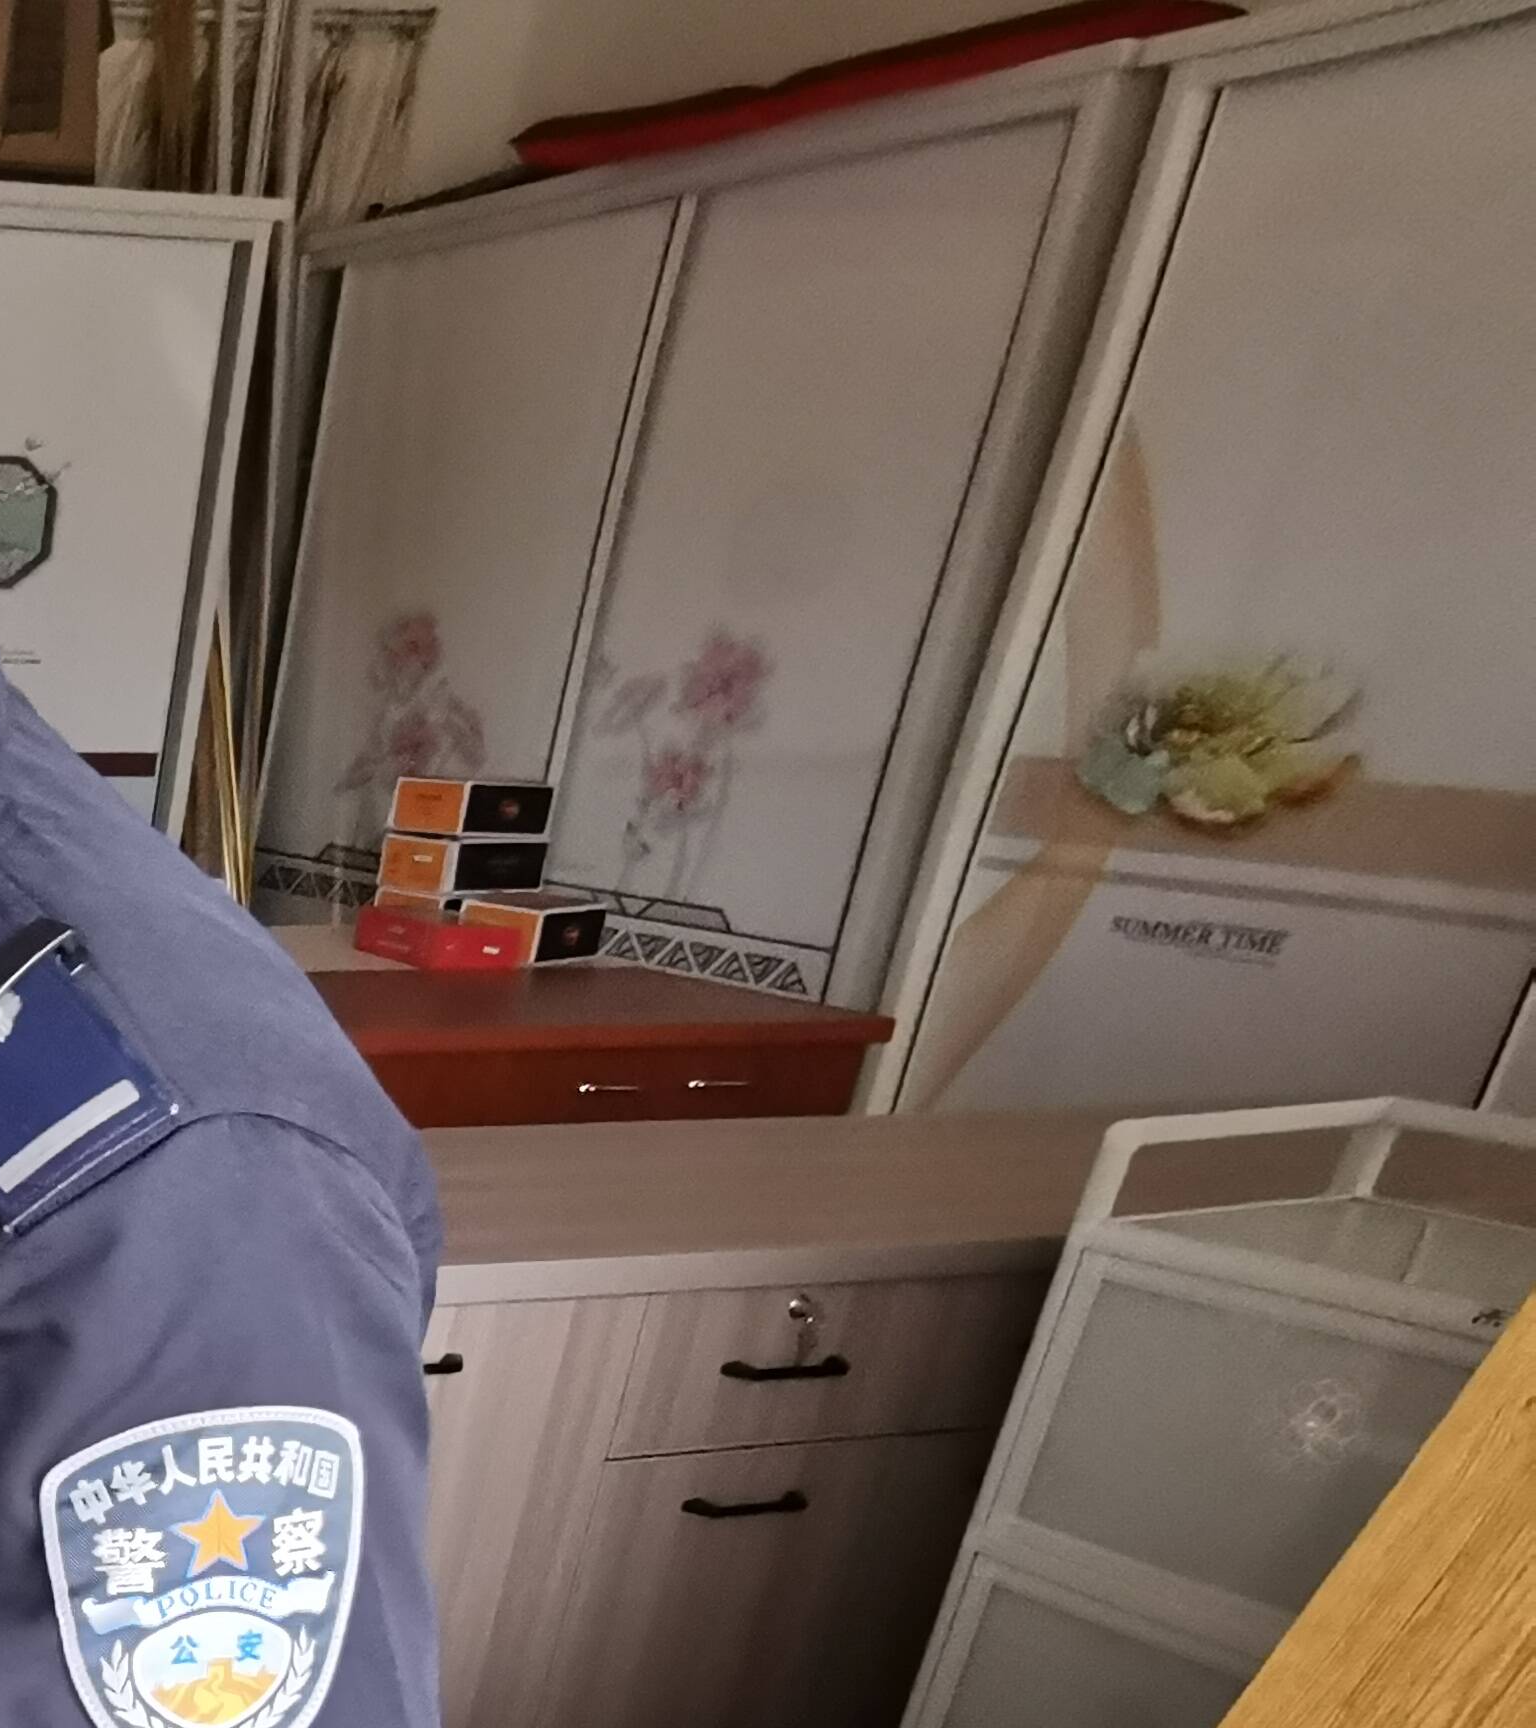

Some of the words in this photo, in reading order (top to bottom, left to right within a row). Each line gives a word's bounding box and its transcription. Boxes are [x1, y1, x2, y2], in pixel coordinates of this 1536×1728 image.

[1110, 916, 1213, 946] SUMMER
[1221, 925, 1290, 954] TIME
[69, 1436, 341, 1525] 中华人民共和国
[154, 1578, 280, 1620] POLICE
